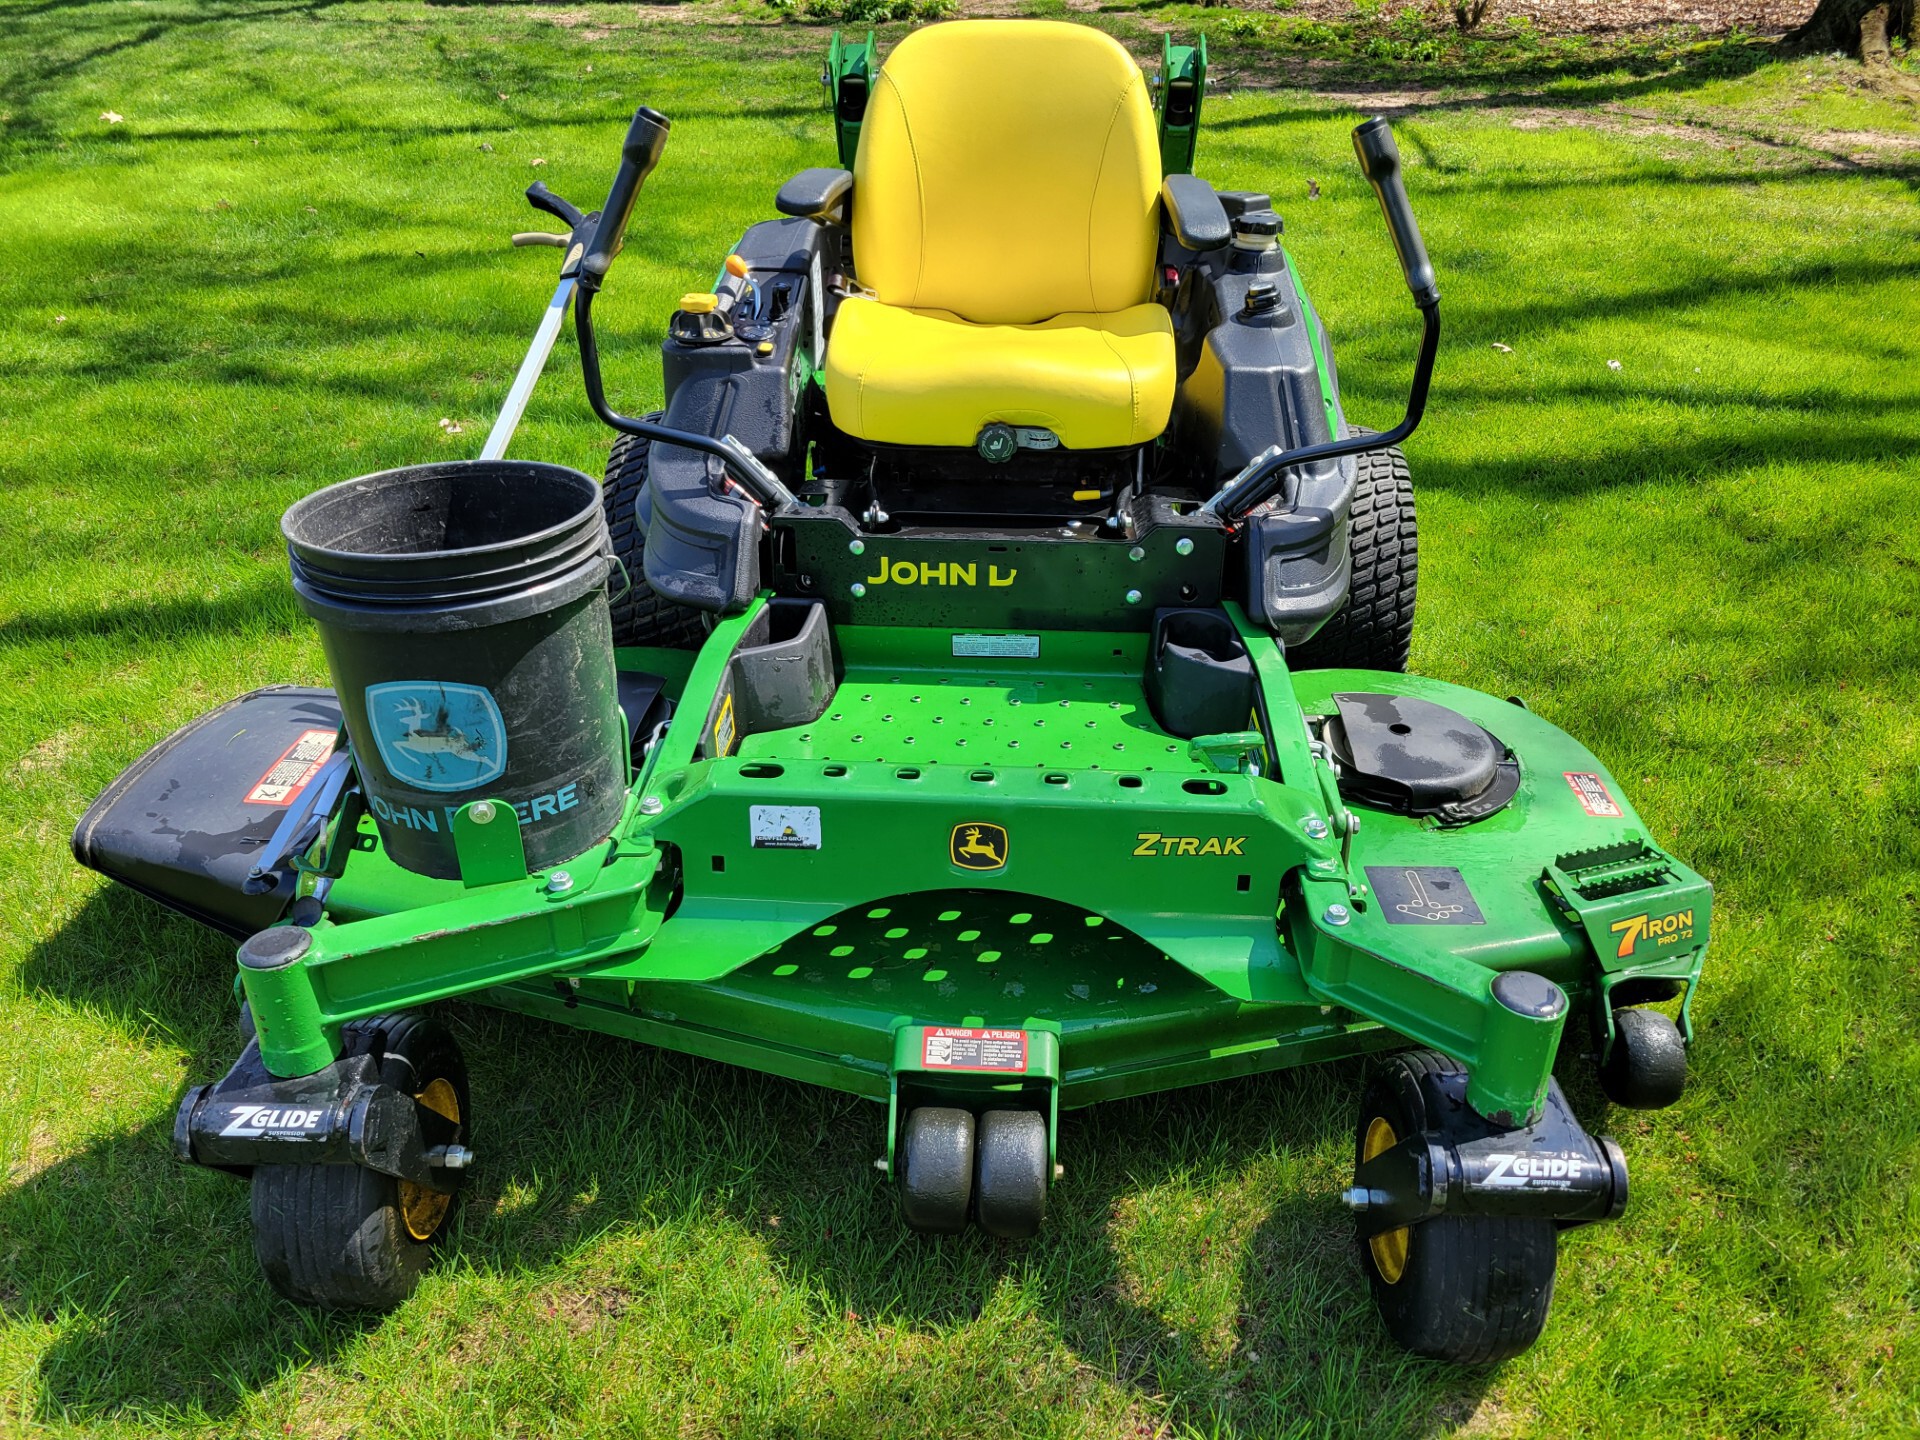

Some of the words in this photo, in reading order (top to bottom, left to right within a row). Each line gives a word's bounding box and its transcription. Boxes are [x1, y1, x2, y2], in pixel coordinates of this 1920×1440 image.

[867, 556, 977, 586] JOHN
[444, 783, 579, 833] ERE
[1133, 833, 1247, 856] ZTRAK
[1657, 934, 1678, 947] PRO
[1681, 929, 1693, 940] 72
[945, 1028, 972, 1037] DANGER
[991, 1030, 1020, 1039] PELIGRO
[219, 1106, 323, 1137] ZGLIDE
[1481, 1154, 1581, 1186] ZGLIDE
[1532, 1179, 1571, 1187] SUSPENSION
